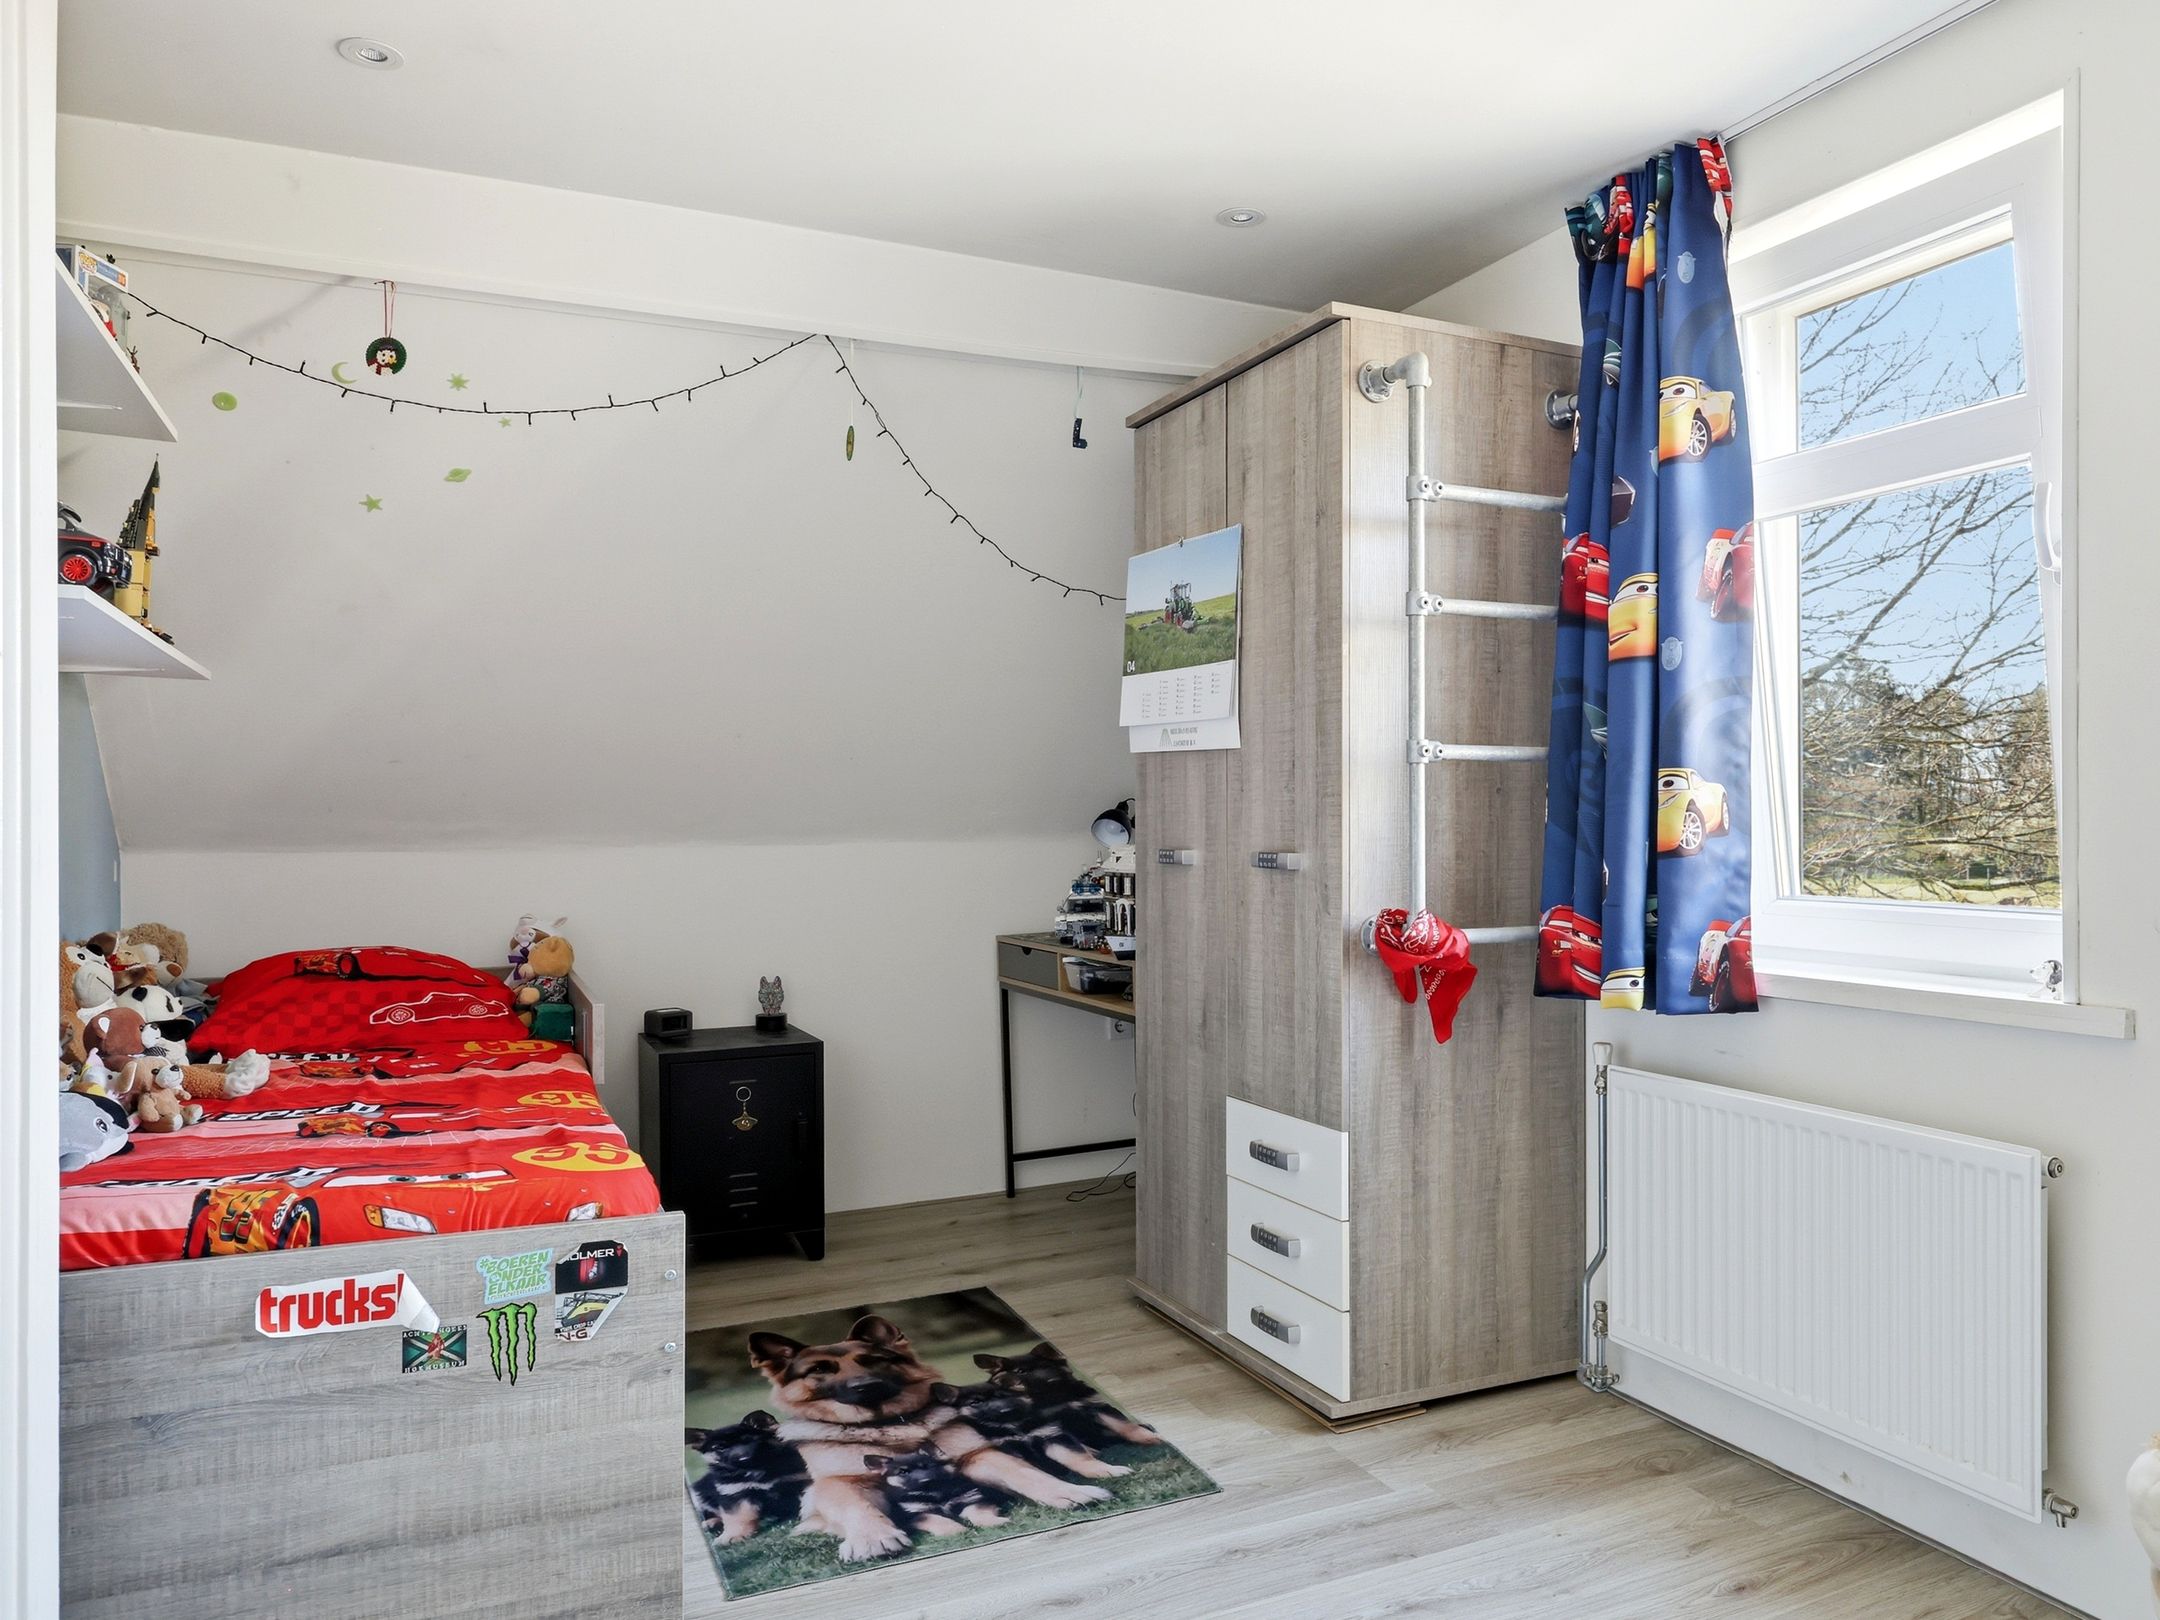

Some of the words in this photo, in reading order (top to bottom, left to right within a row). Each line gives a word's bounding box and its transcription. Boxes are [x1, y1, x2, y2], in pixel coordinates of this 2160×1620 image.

[1126, 661, 1136, 672] 04
[217, 1102, 382, 1121] SPEED
[530, 1144, 630, 1165] 95
[480, 1250, 549, 1274] #BOEREN
[566, 1248, 615, 1261] OLMER
[489, 1264, 542, 1284] ONDER
[488, 1273, 547, 1296] ELKAAR
